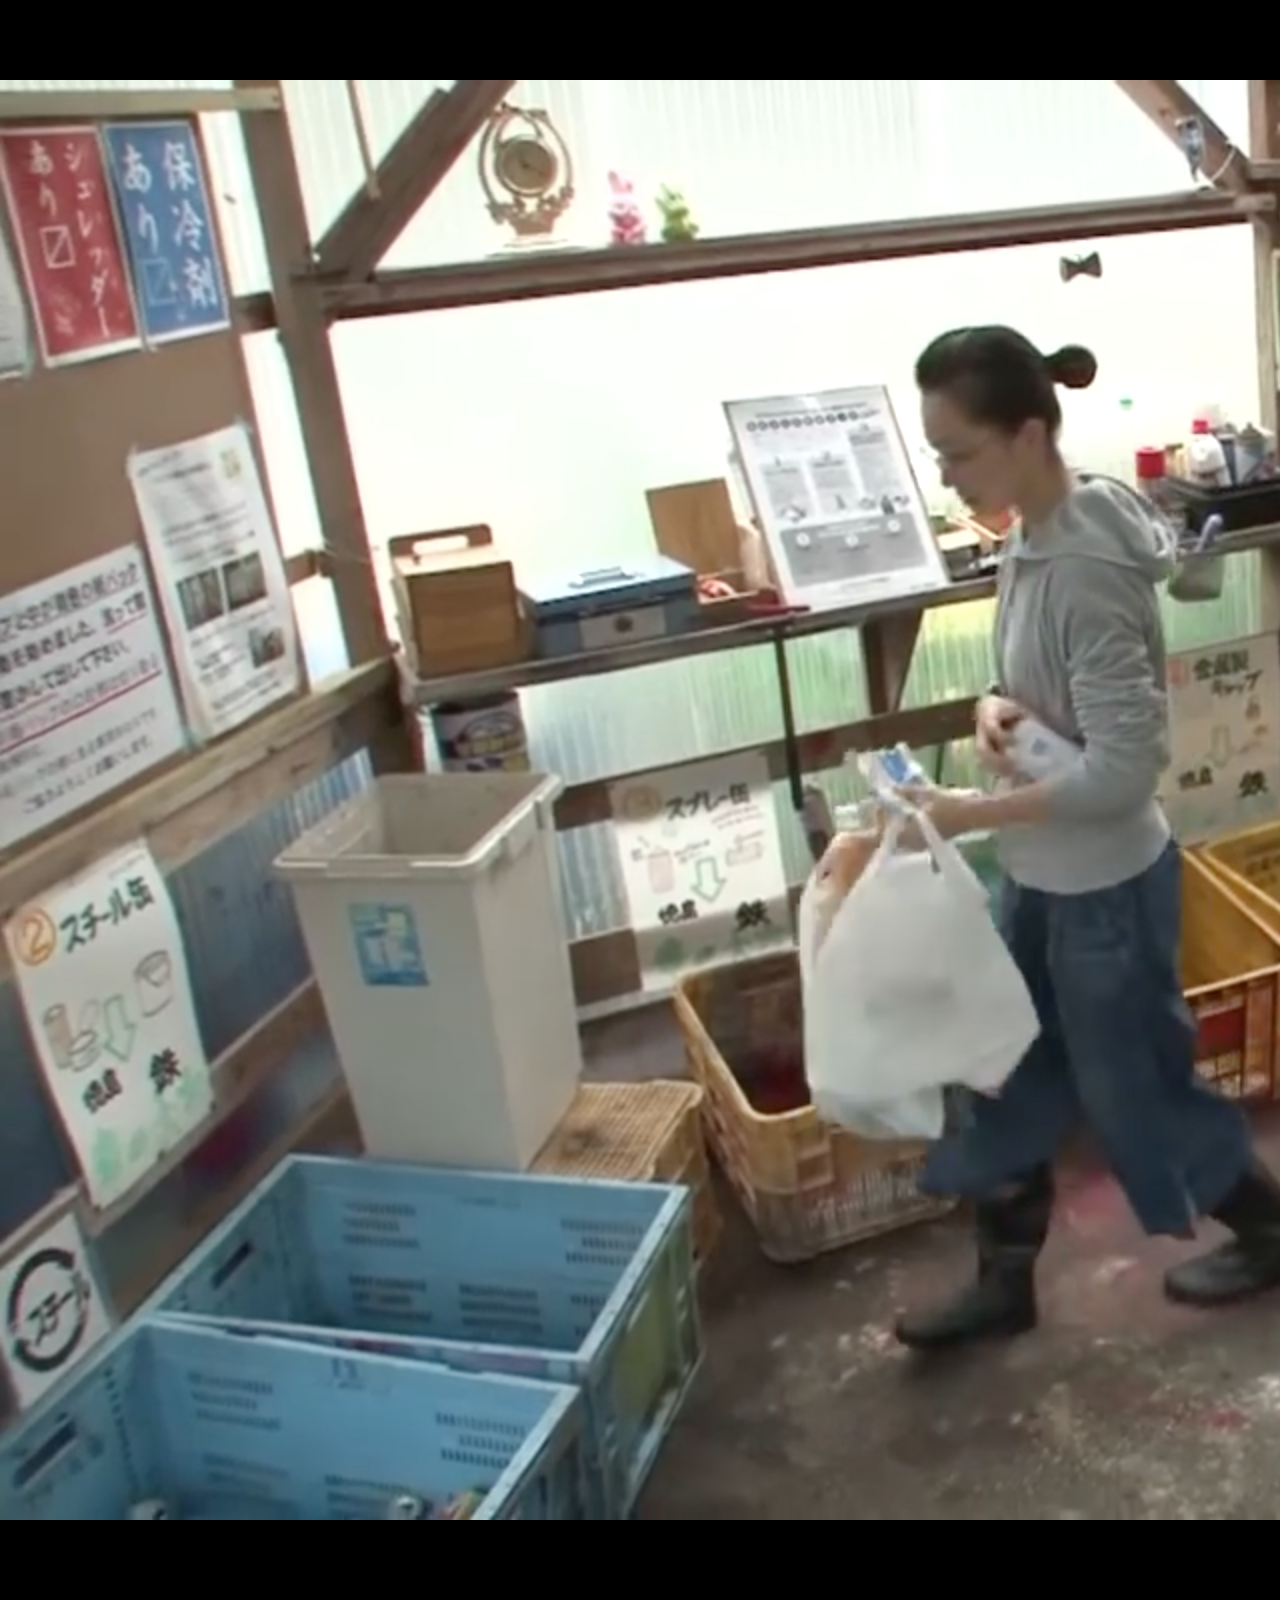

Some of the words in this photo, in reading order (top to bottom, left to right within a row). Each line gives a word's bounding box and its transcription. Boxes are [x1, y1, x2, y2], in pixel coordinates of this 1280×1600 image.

[28, 141, 58, 218] あり
[123, 144, 159, 254] あり
[161, 141, 219, 308] 保冷剤
[62, 142, 111, 338] シュレッダー
[666, 782, 750, 820] スプレー缶
[60, 876, 156, 953] スチール缶
